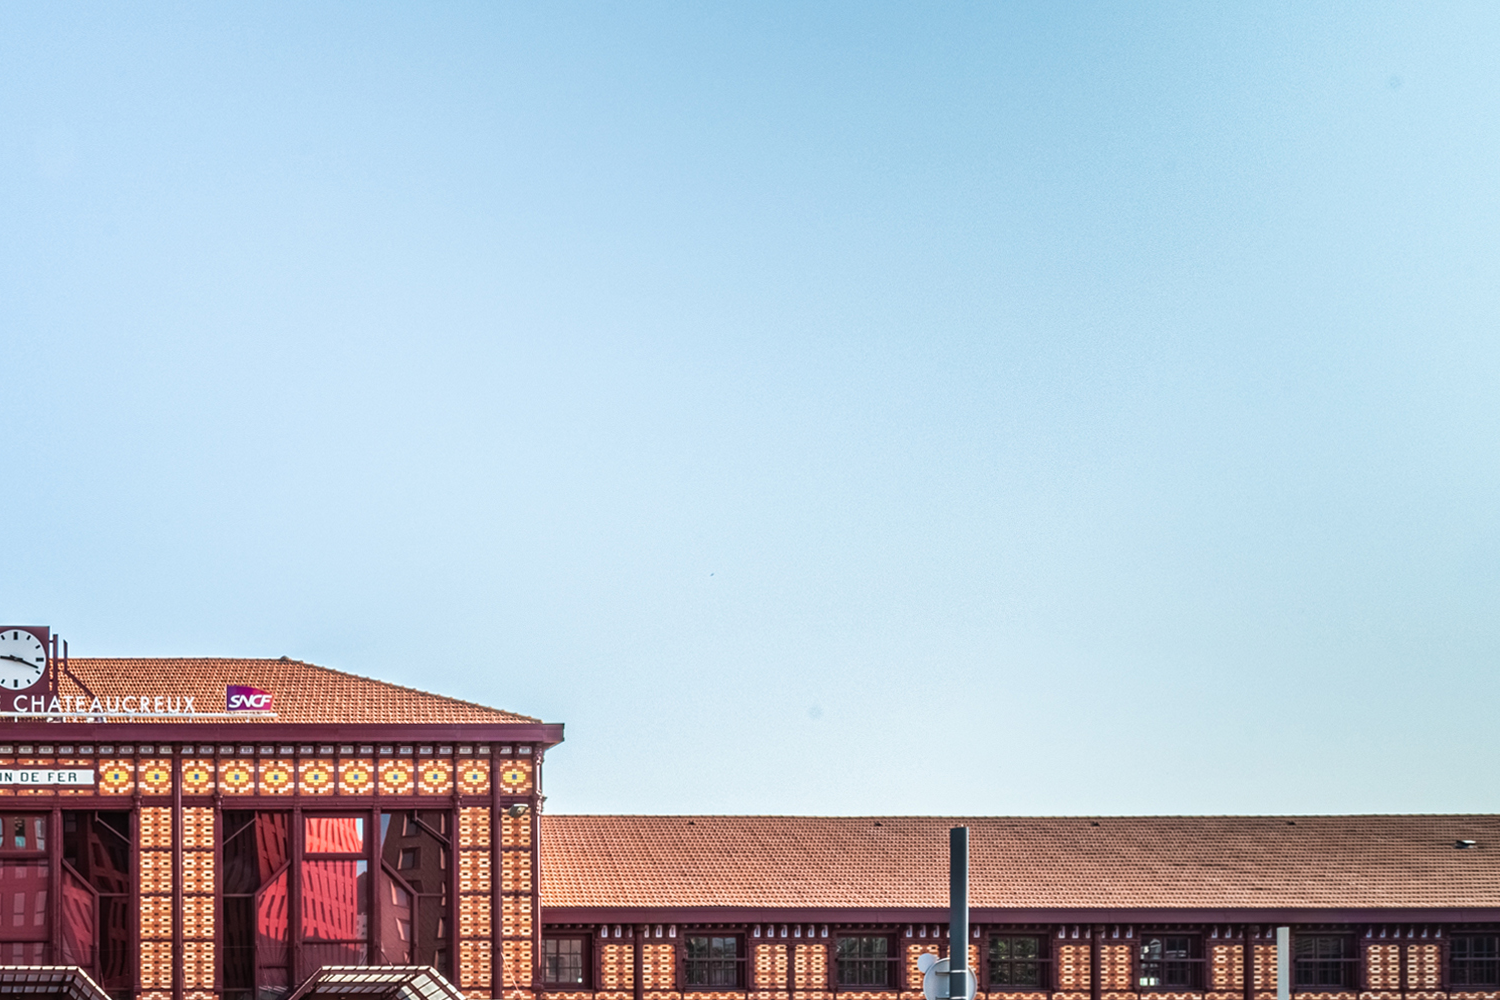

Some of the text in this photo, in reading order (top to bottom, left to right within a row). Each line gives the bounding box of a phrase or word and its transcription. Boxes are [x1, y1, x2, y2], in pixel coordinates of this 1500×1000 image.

[13, 695, 195, 714] CHATEAUCREUX
[228, 694, 273, 708] SNCF
[20, 772, 40, 782] DE
[47, 772, 78, 782] FER
